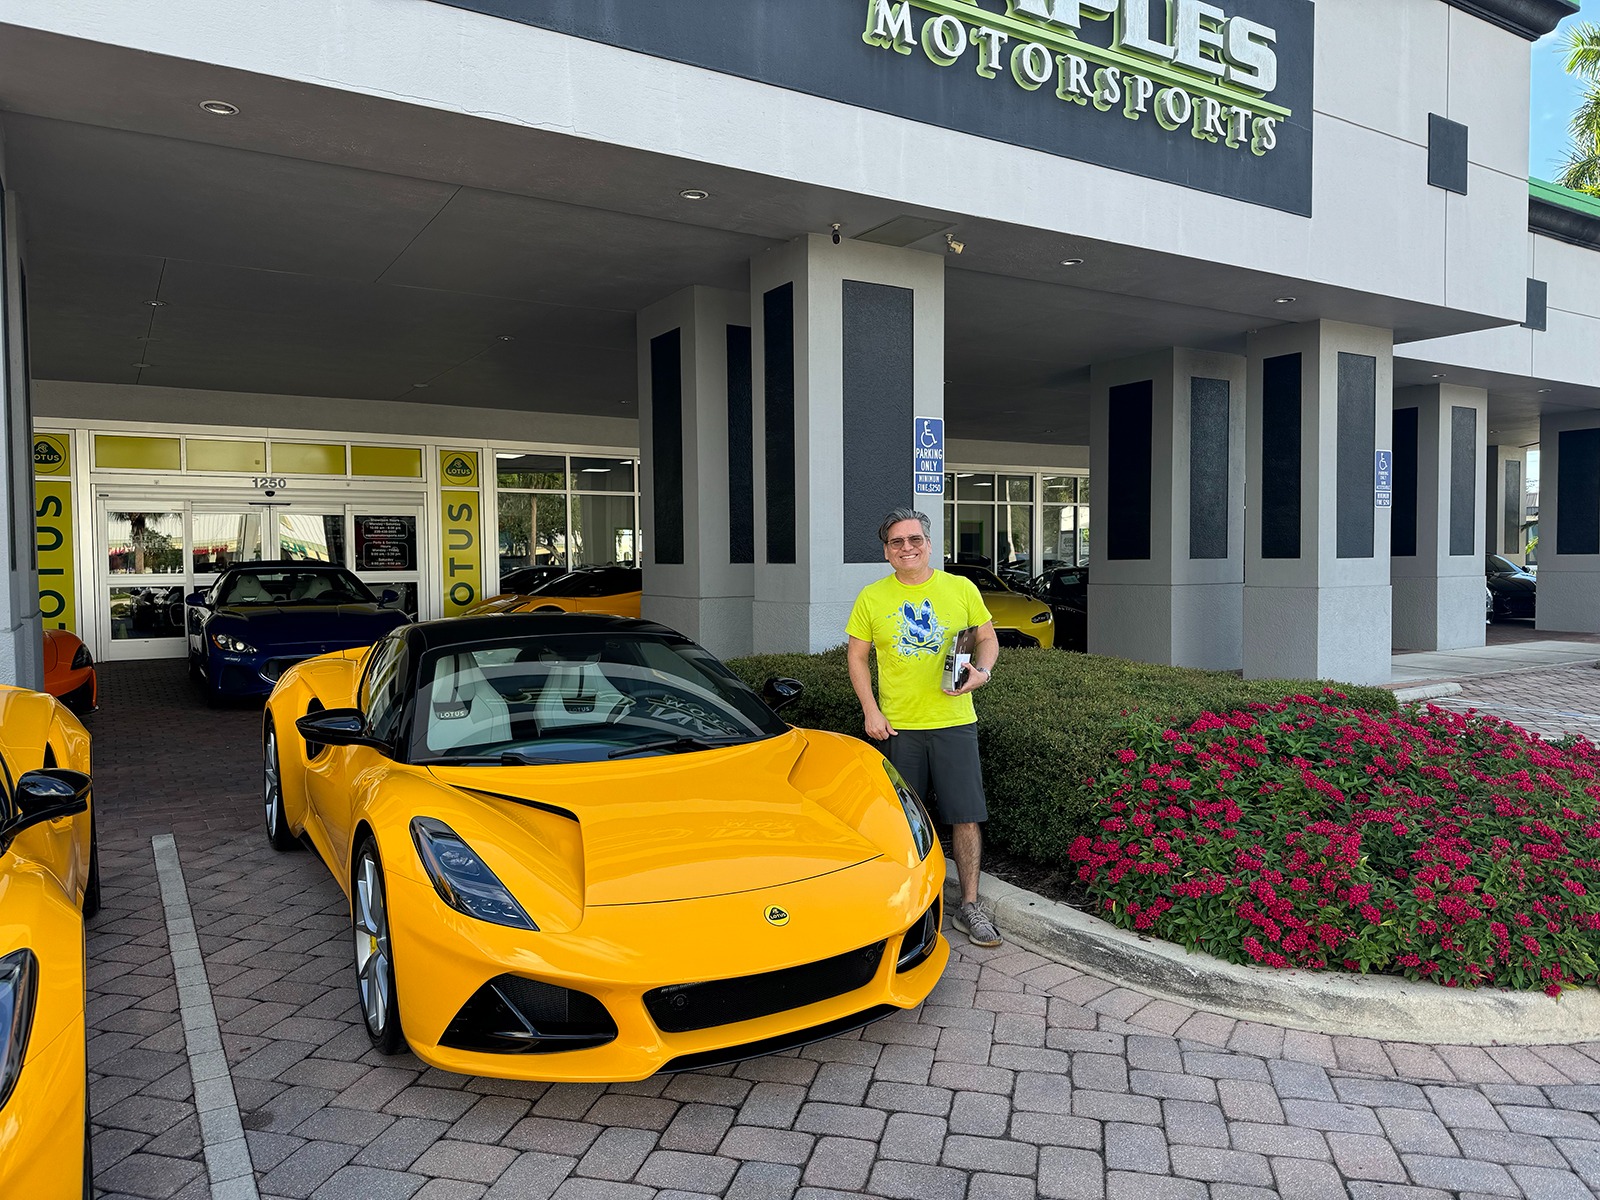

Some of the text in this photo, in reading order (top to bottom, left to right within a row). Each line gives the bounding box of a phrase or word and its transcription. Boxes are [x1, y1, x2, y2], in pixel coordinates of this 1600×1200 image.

[866, 0, 1277, 153] MOTORSPORTS
[33, 453, 60, 461] OTUS
[915, 448, 943, 460] PARKING
[920, 460, 938, 472] ONLY
[252, 477, 287, 489] 1250
[447, 502, 475, 607] OTUS
[440, 710, 465, 718] LOTUS
